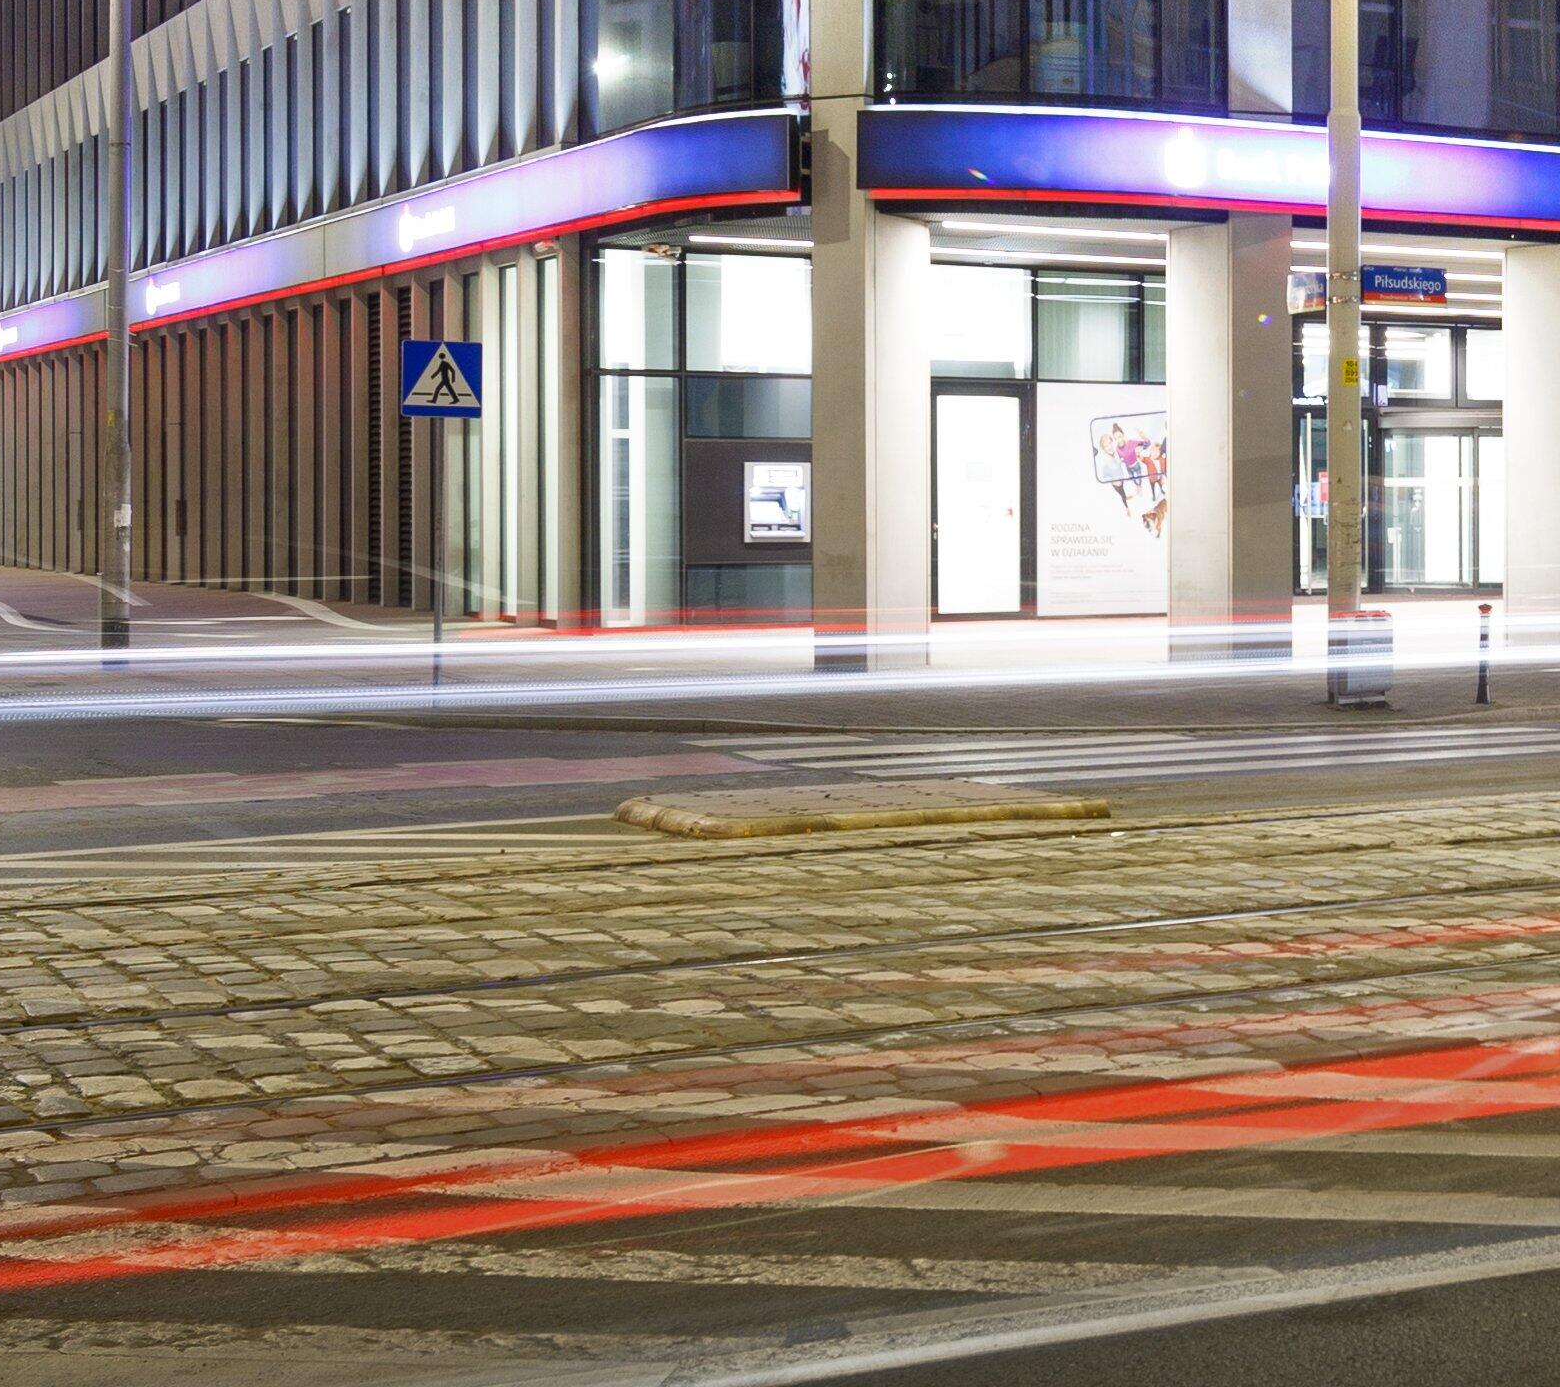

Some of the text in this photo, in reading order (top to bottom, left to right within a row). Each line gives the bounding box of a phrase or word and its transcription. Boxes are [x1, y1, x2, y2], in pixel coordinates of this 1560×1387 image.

[1374, 274, 1442, 294] Piłsudskiego
[1050, 522, 1091, 532] RODZINA
[1049, 535, 1099, 545] SPRAWDZA
[1049, 547, 1109, 557] W DZIAŁANIU
